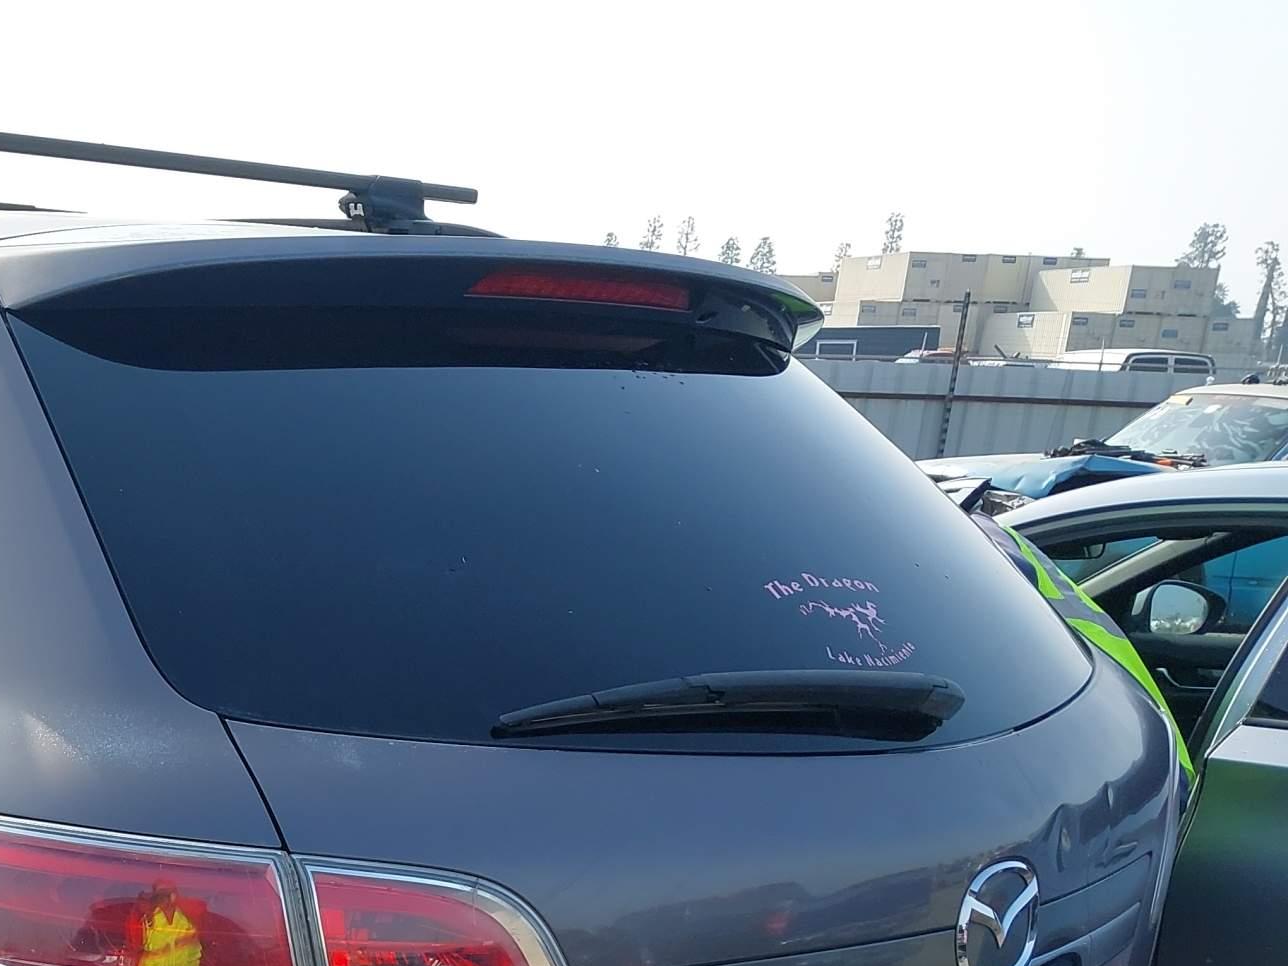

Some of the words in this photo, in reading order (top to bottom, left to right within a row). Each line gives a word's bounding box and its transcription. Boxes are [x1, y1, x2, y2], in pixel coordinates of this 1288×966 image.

[764, 579, 804, 600] The
[801, 572, 880, 593] Dragon
[825, 646, 863, 667] Lake
